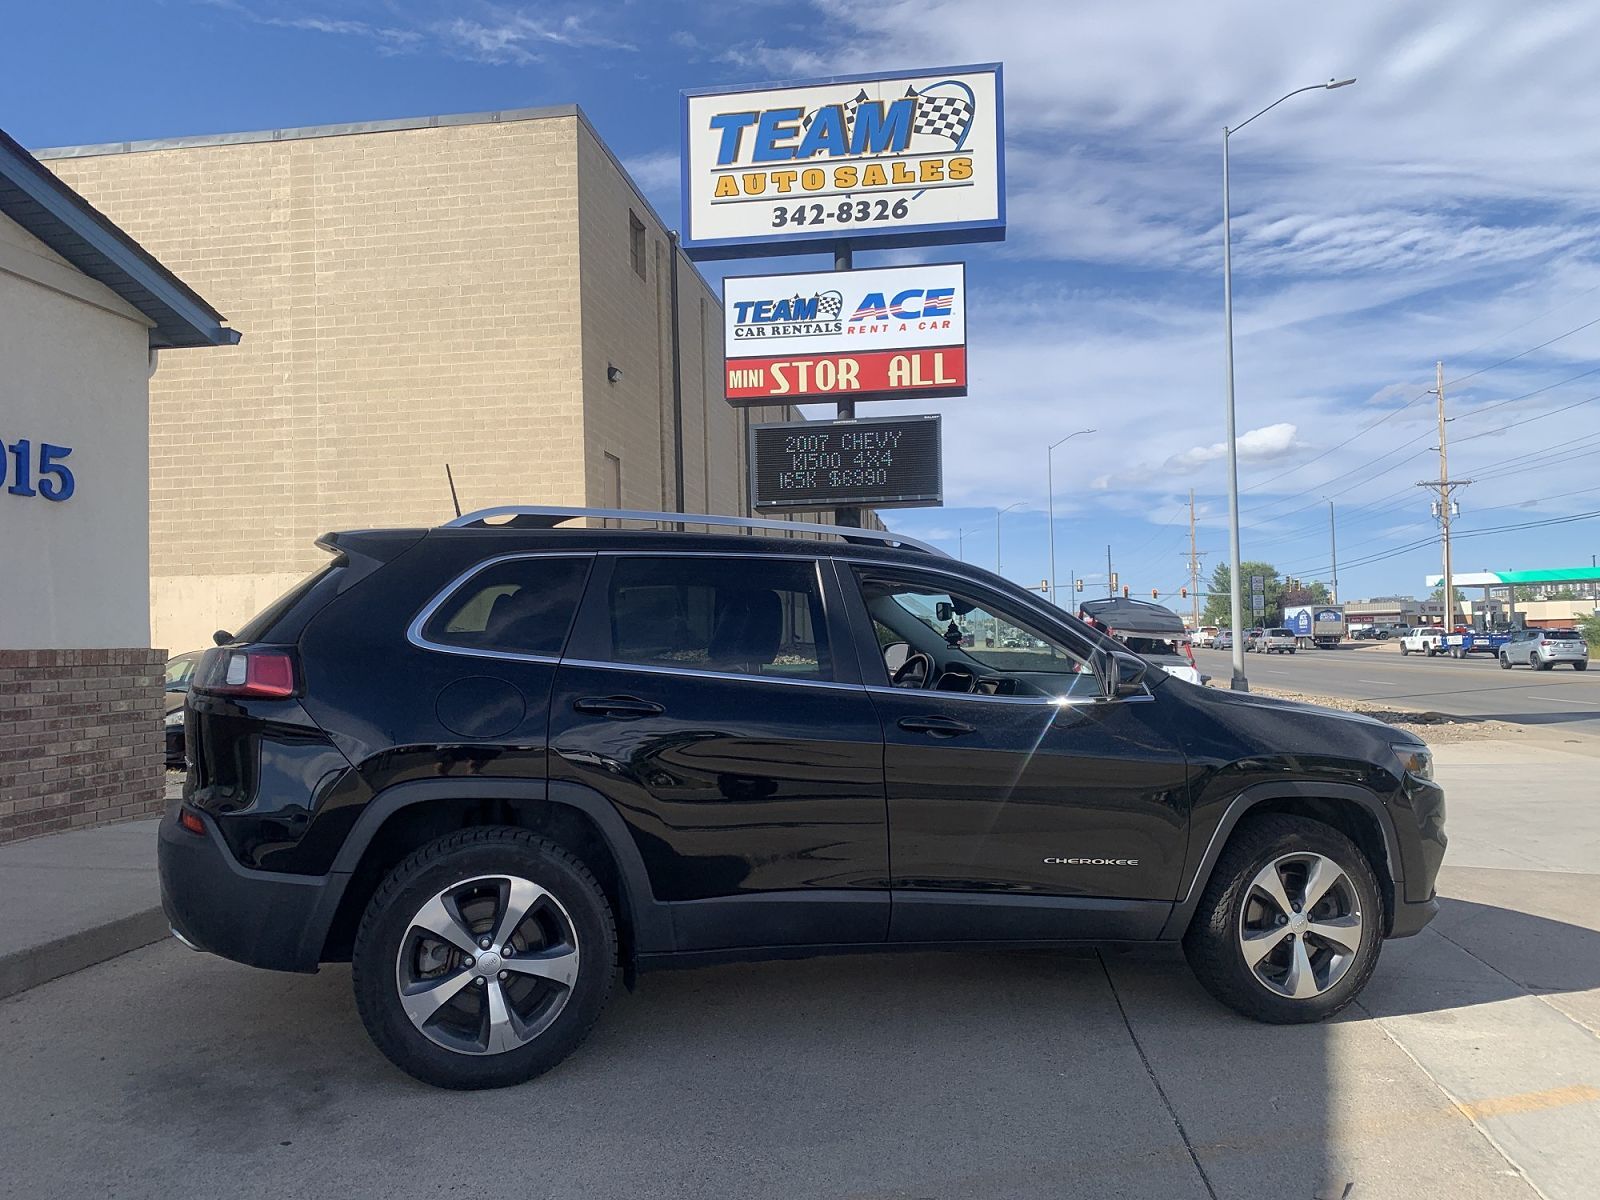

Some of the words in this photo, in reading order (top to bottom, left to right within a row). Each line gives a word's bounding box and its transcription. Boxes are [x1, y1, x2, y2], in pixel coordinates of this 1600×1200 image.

[709, 98, 919, 166] TEAM
[714, 168, 826, 198] AUTO
[834, 157, 974, 188] SALES
[771, 198, 909, 228] 342-8326
[733, 297, 820, 325] TEAM
[849, 287, 956, 322] ACE
[734, 325, 766, 338] CAR
[771, 322, 843, 336] RENTALS
[847, 324, 889, 335] RENT
[899, 321, 907, 332] A
[918, 320, 951, 331] CAR
[729, 368, 764, 389] MINI
[769, 358, 861, 394] STOR
[887, 352, 957, 387] ALL
[785, 433, 829, 453] 2007
[841, 430, 902, 450] CHEVY
[0, 439, 75, 502] 15
[792, 451, 841, 471] K1500
[779, 470, 817, 489] 165K
[828, 468, 887, 487] $6990
[1043, 857, 1139, 866] CHEROKEE
